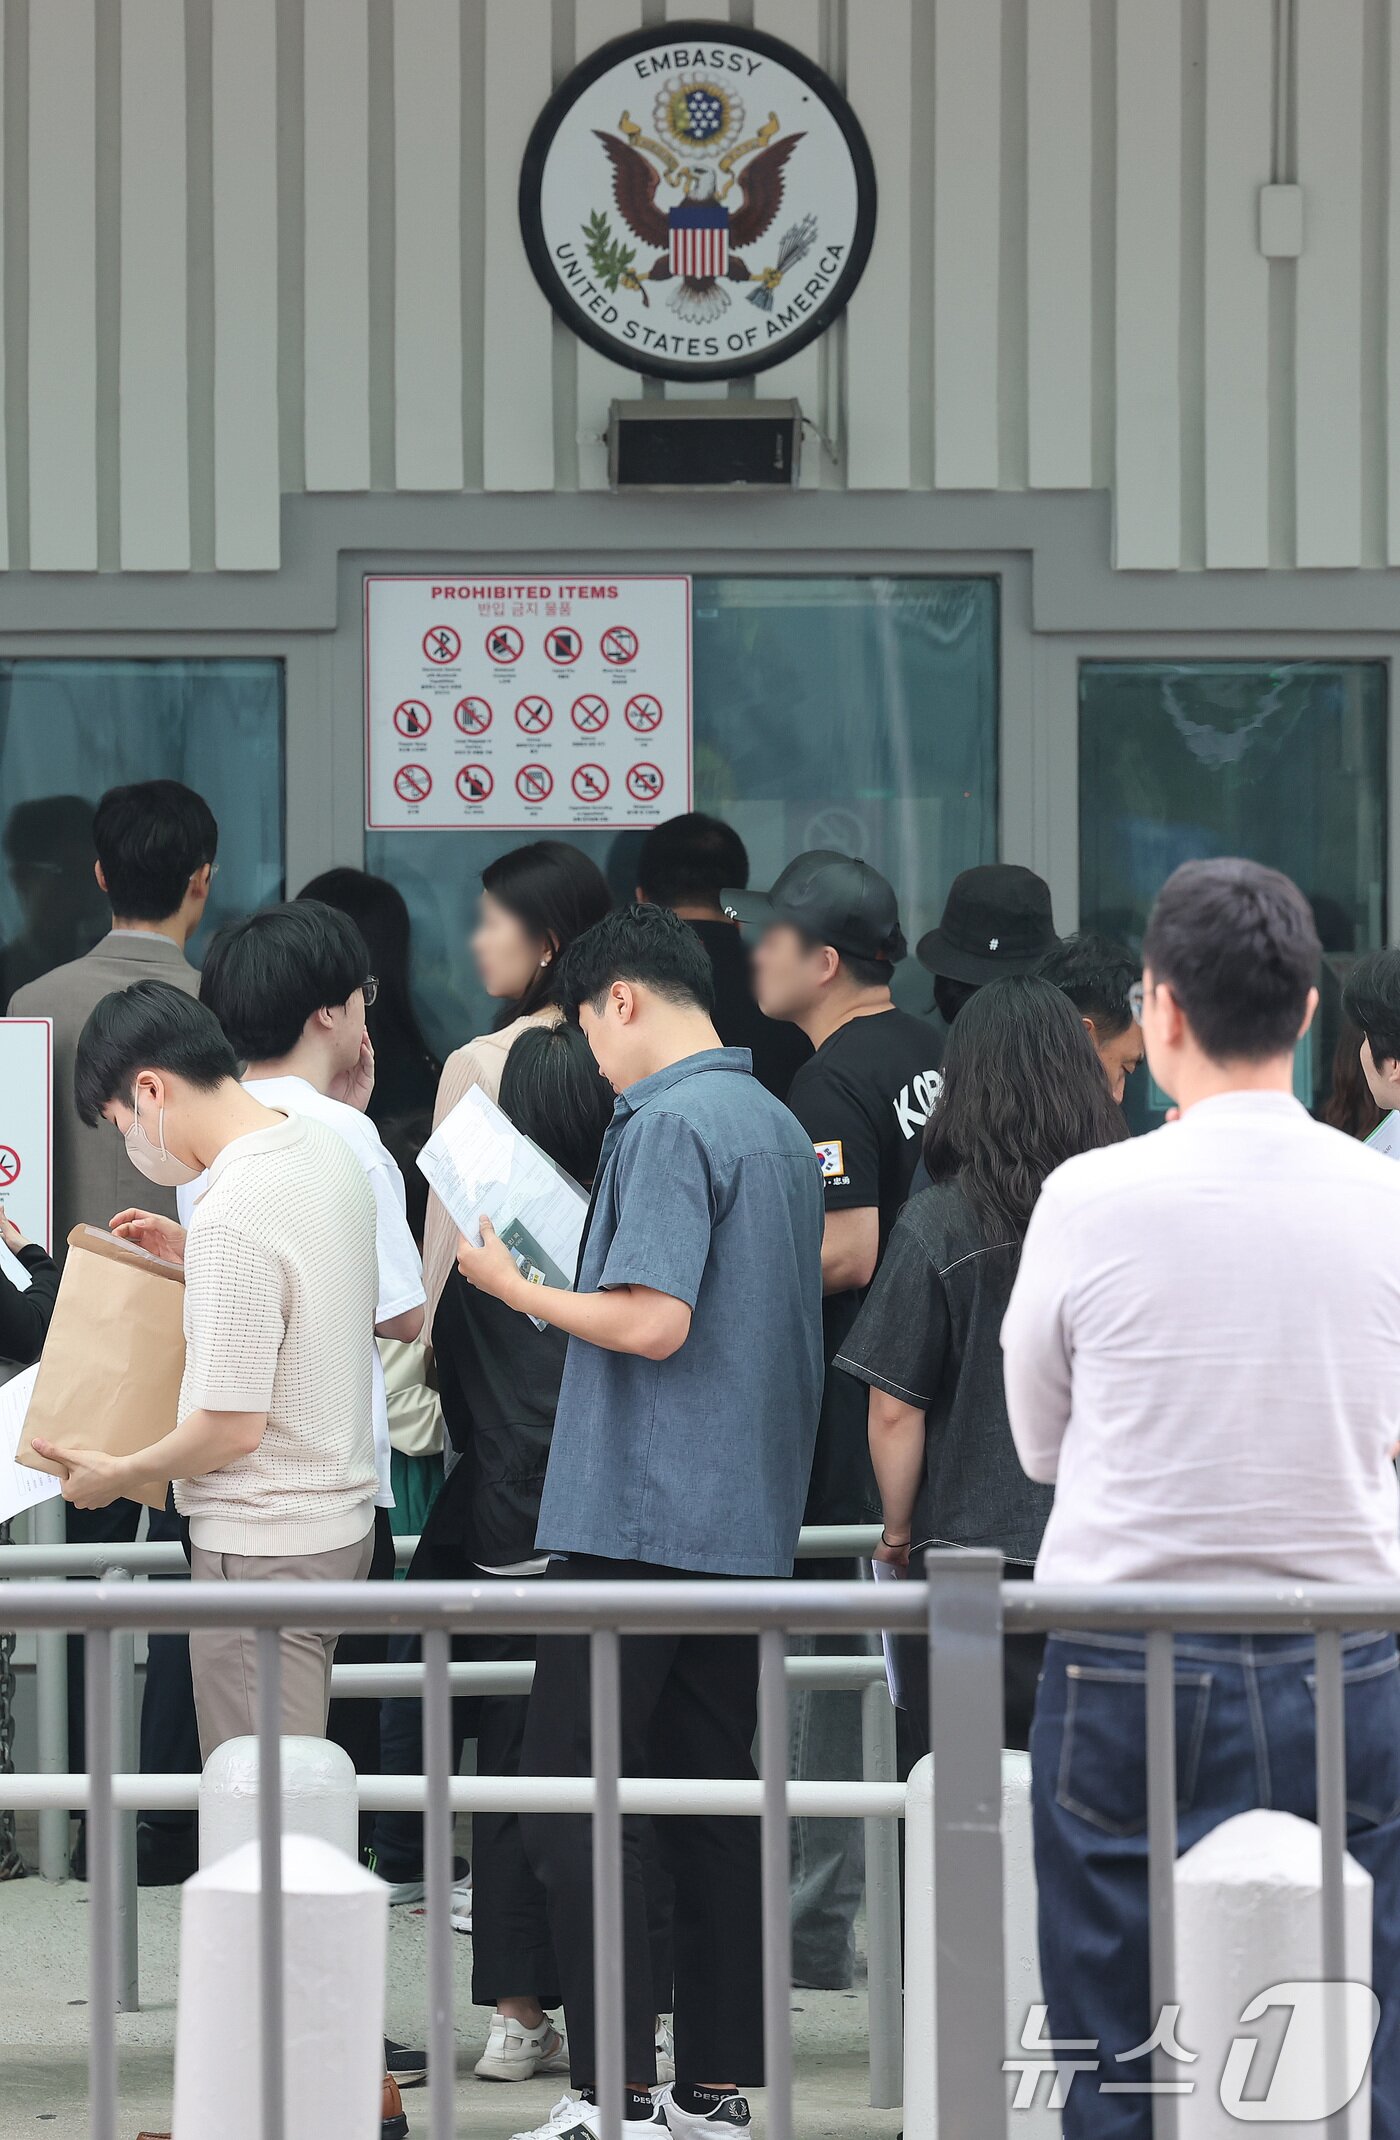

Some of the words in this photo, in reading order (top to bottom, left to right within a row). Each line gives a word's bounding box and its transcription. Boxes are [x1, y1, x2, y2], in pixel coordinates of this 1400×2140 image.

[634, 49, 762, 79] EMBASSY
[556, 243, 618, 324] UNITED
[622, 320, 719, 356] STATES
[727, 326, 757, 352] OF
[766, 245, 844, 338] AMERICA
[431, 586, 551, 599] PROHIBITED
[559, 586, 619, 599] ITEMS
[478, 601, 505, 617] 반입
[512, 601, 538, 617] 금지
[545, 601, 572, 617] 물품
